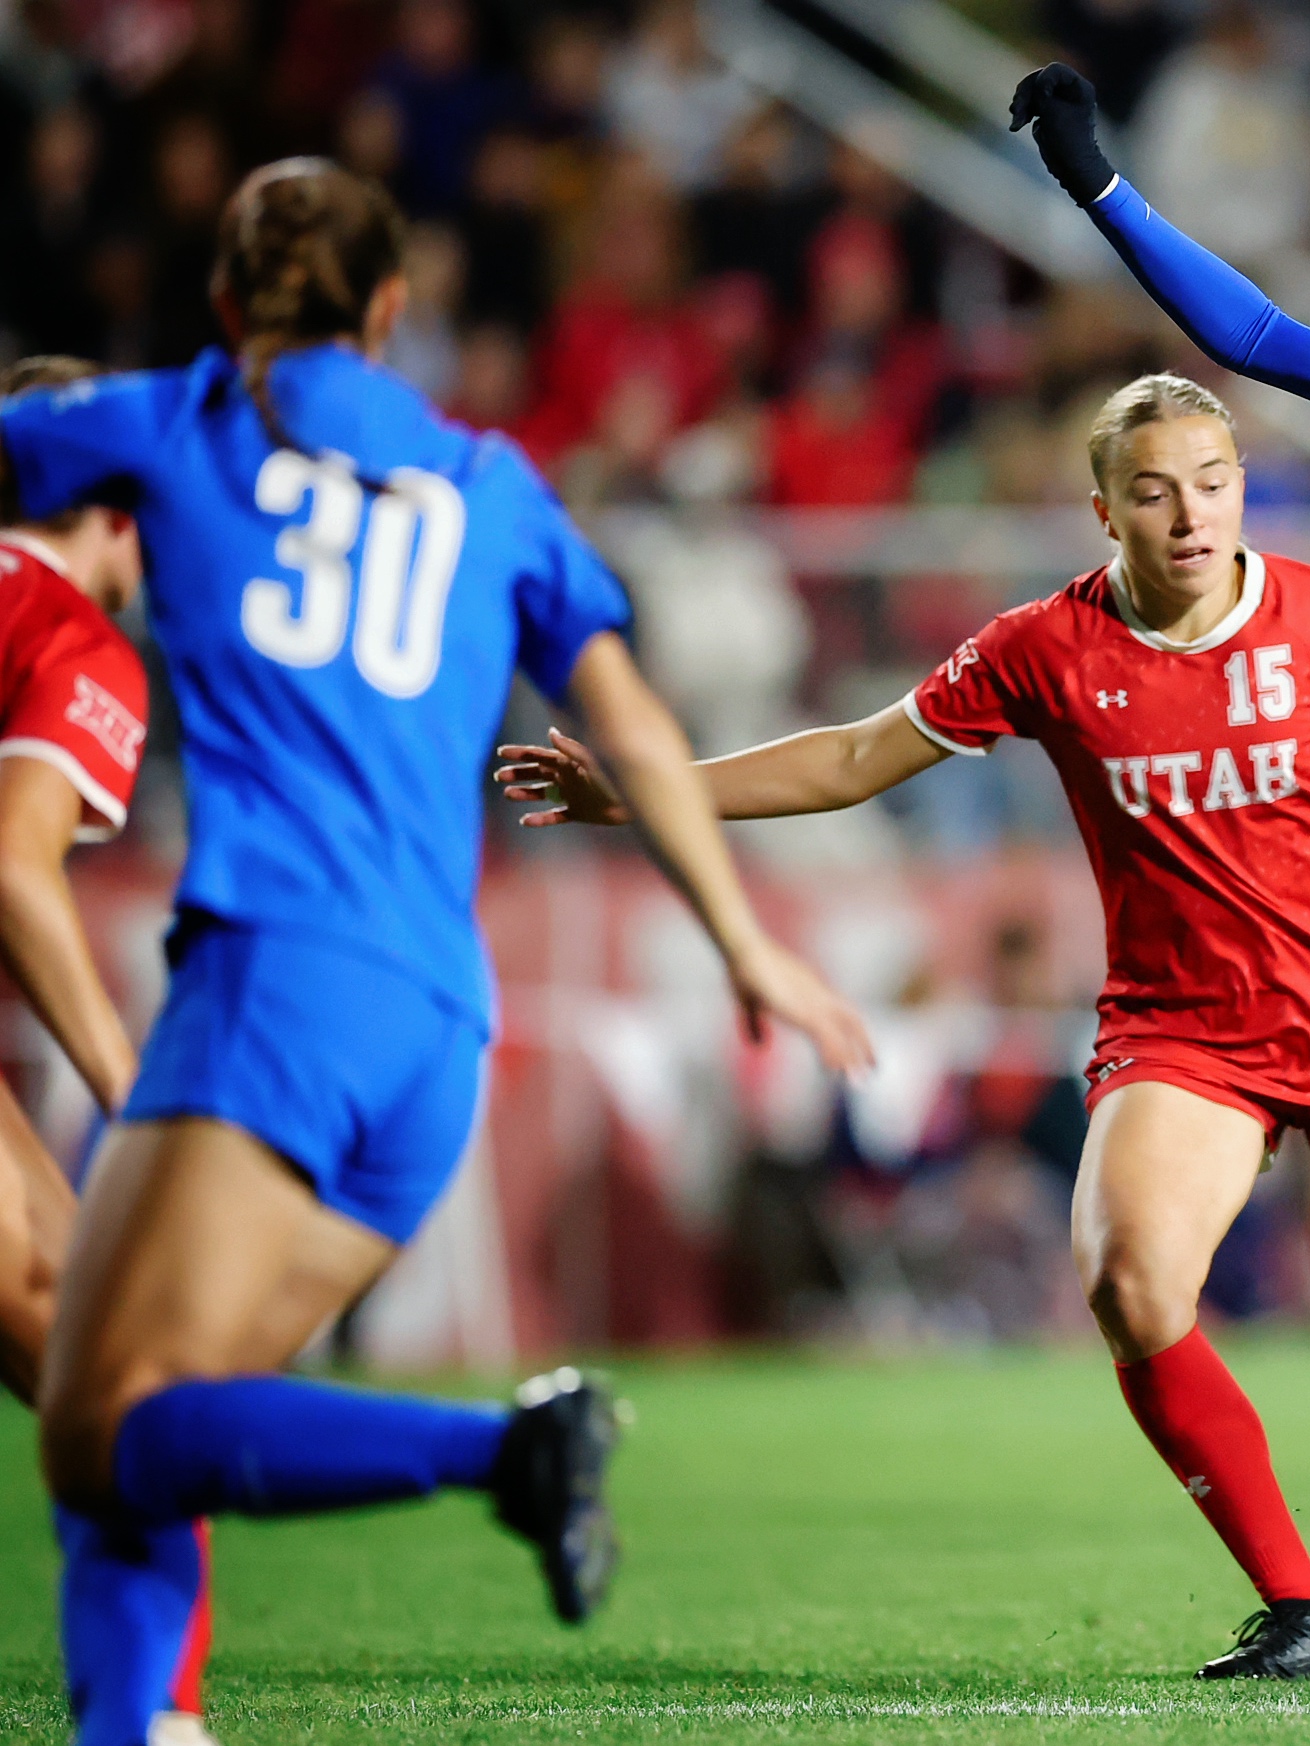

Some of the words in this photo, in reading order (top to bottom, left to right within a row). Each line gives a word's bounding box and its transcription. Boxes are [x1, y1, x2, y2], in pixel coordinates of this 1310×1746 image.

[242, 447, 465, 698] 30
[1225, 644, 1296, 726] 15
[1103, 738, 1299, 818] UTAH
